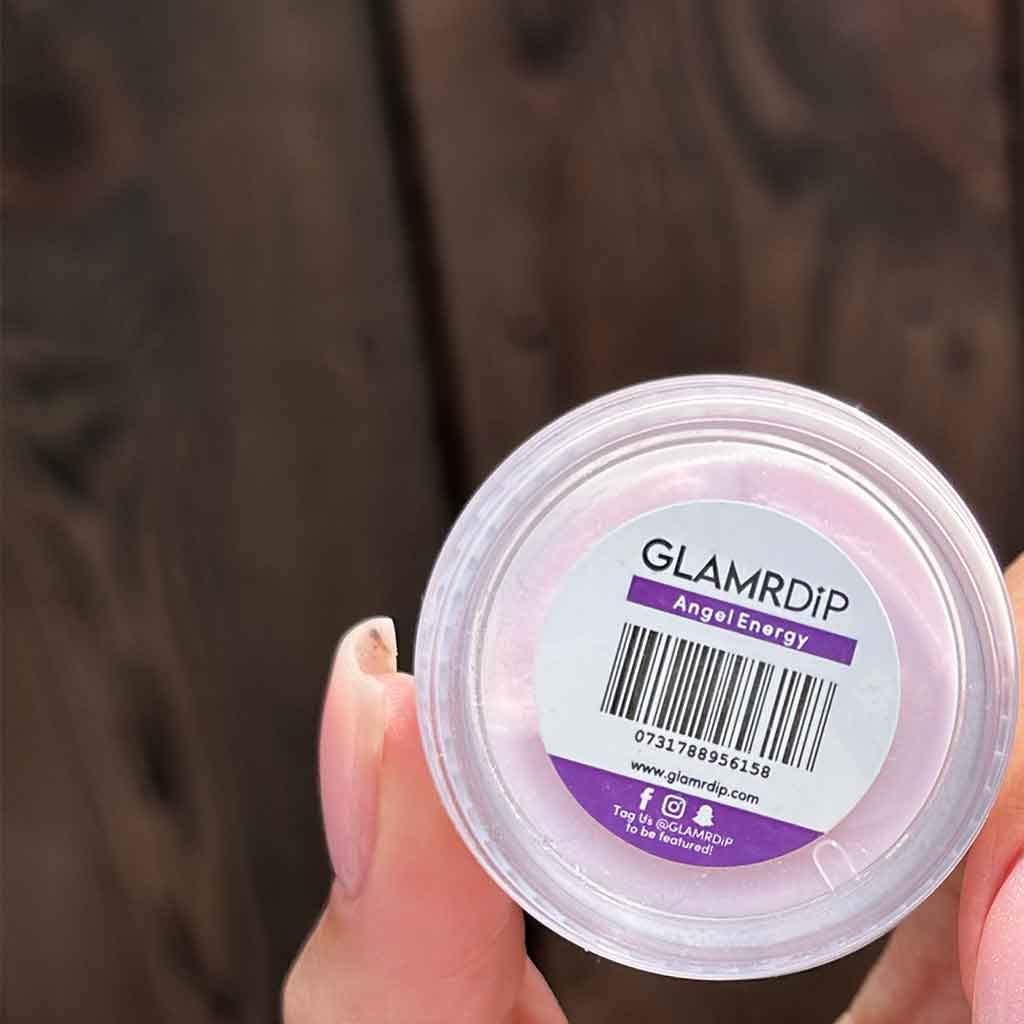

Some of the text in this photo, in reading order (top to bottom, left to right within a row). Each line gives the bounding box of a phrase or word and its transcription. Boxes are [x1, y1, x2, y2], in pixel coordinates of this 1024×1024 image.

[642, 538, 849, 620] GLAMRDiP
[673, 595, 809, 649] Angel Energy
[634, 729, 771, 779] 0731788956158
[631, 761, 759, 805] www.glamrdip.com
[612, 804, 636, 824] Tag
[639, 813, 653, 826] Us
[626, 823, 714, 856] to be featured!
